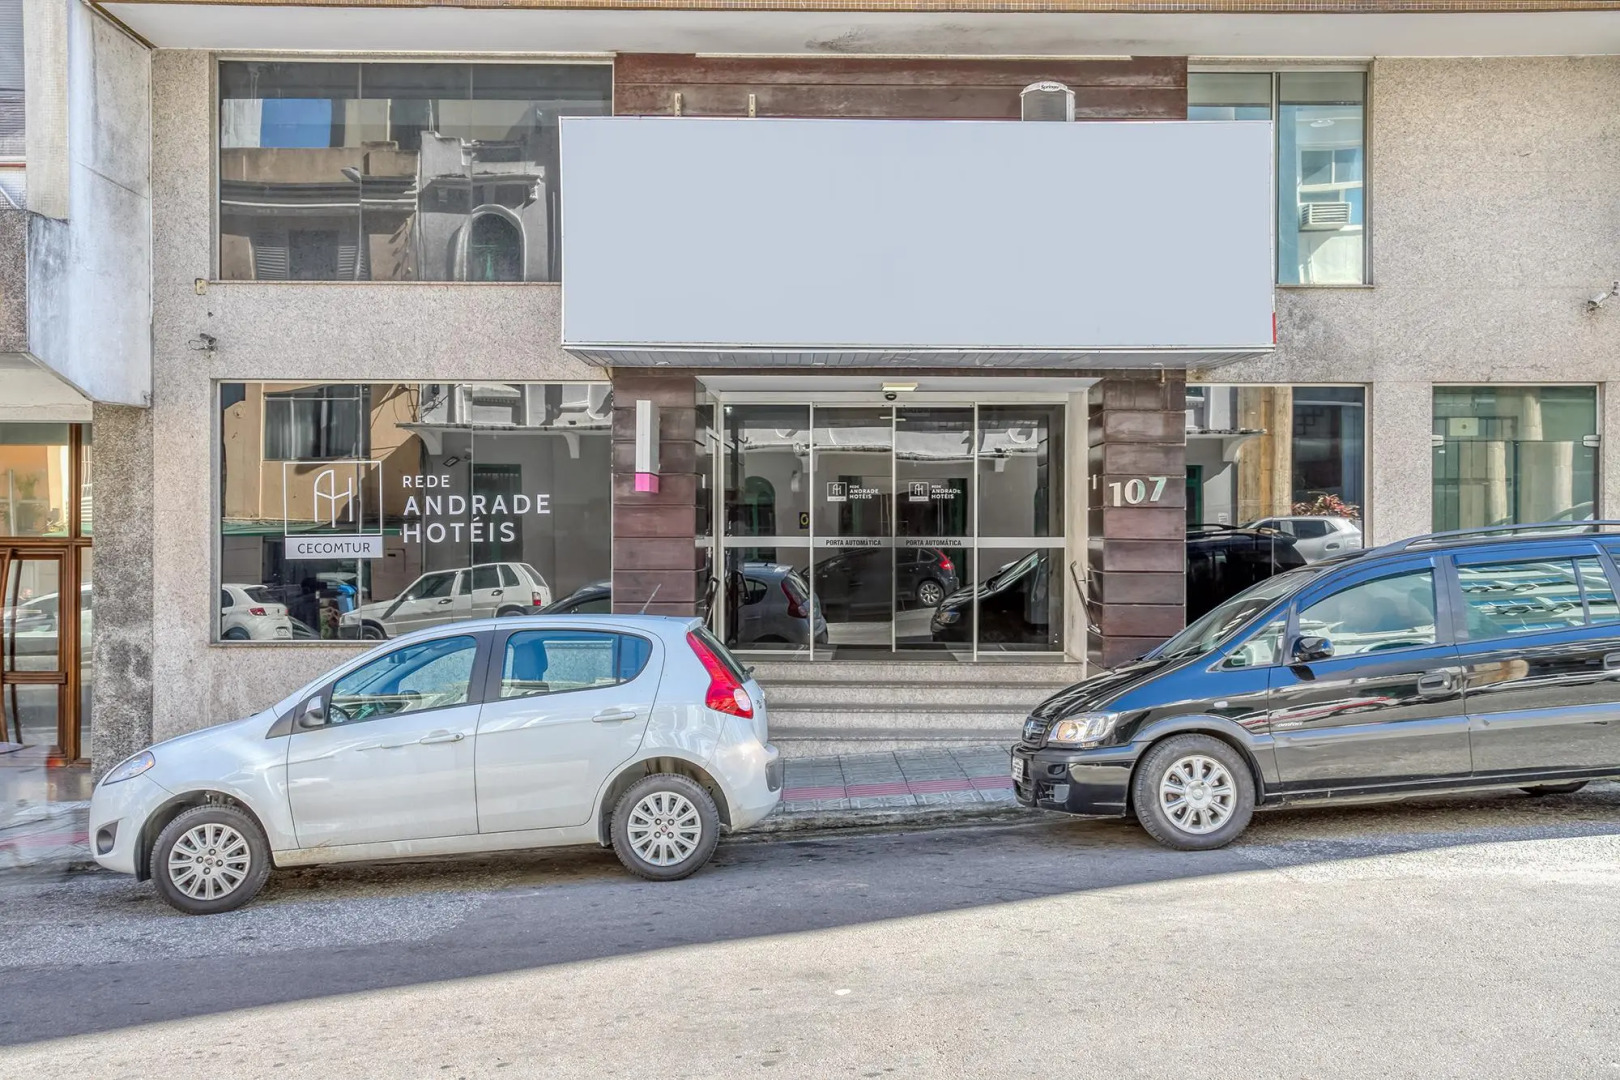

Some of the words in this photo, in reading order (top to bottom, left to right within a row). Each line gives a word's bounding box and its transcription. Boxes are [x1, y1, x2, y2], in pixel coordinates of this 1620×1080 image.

[403, 475, 450, 488] REDE
[1108, 476, 1167, 507] 107
[403, 493, 551, 516] ANDRADE
[403, 516, 515, 544] HOTÉIS
[297, 542, 371, 554] CECOMTUR
